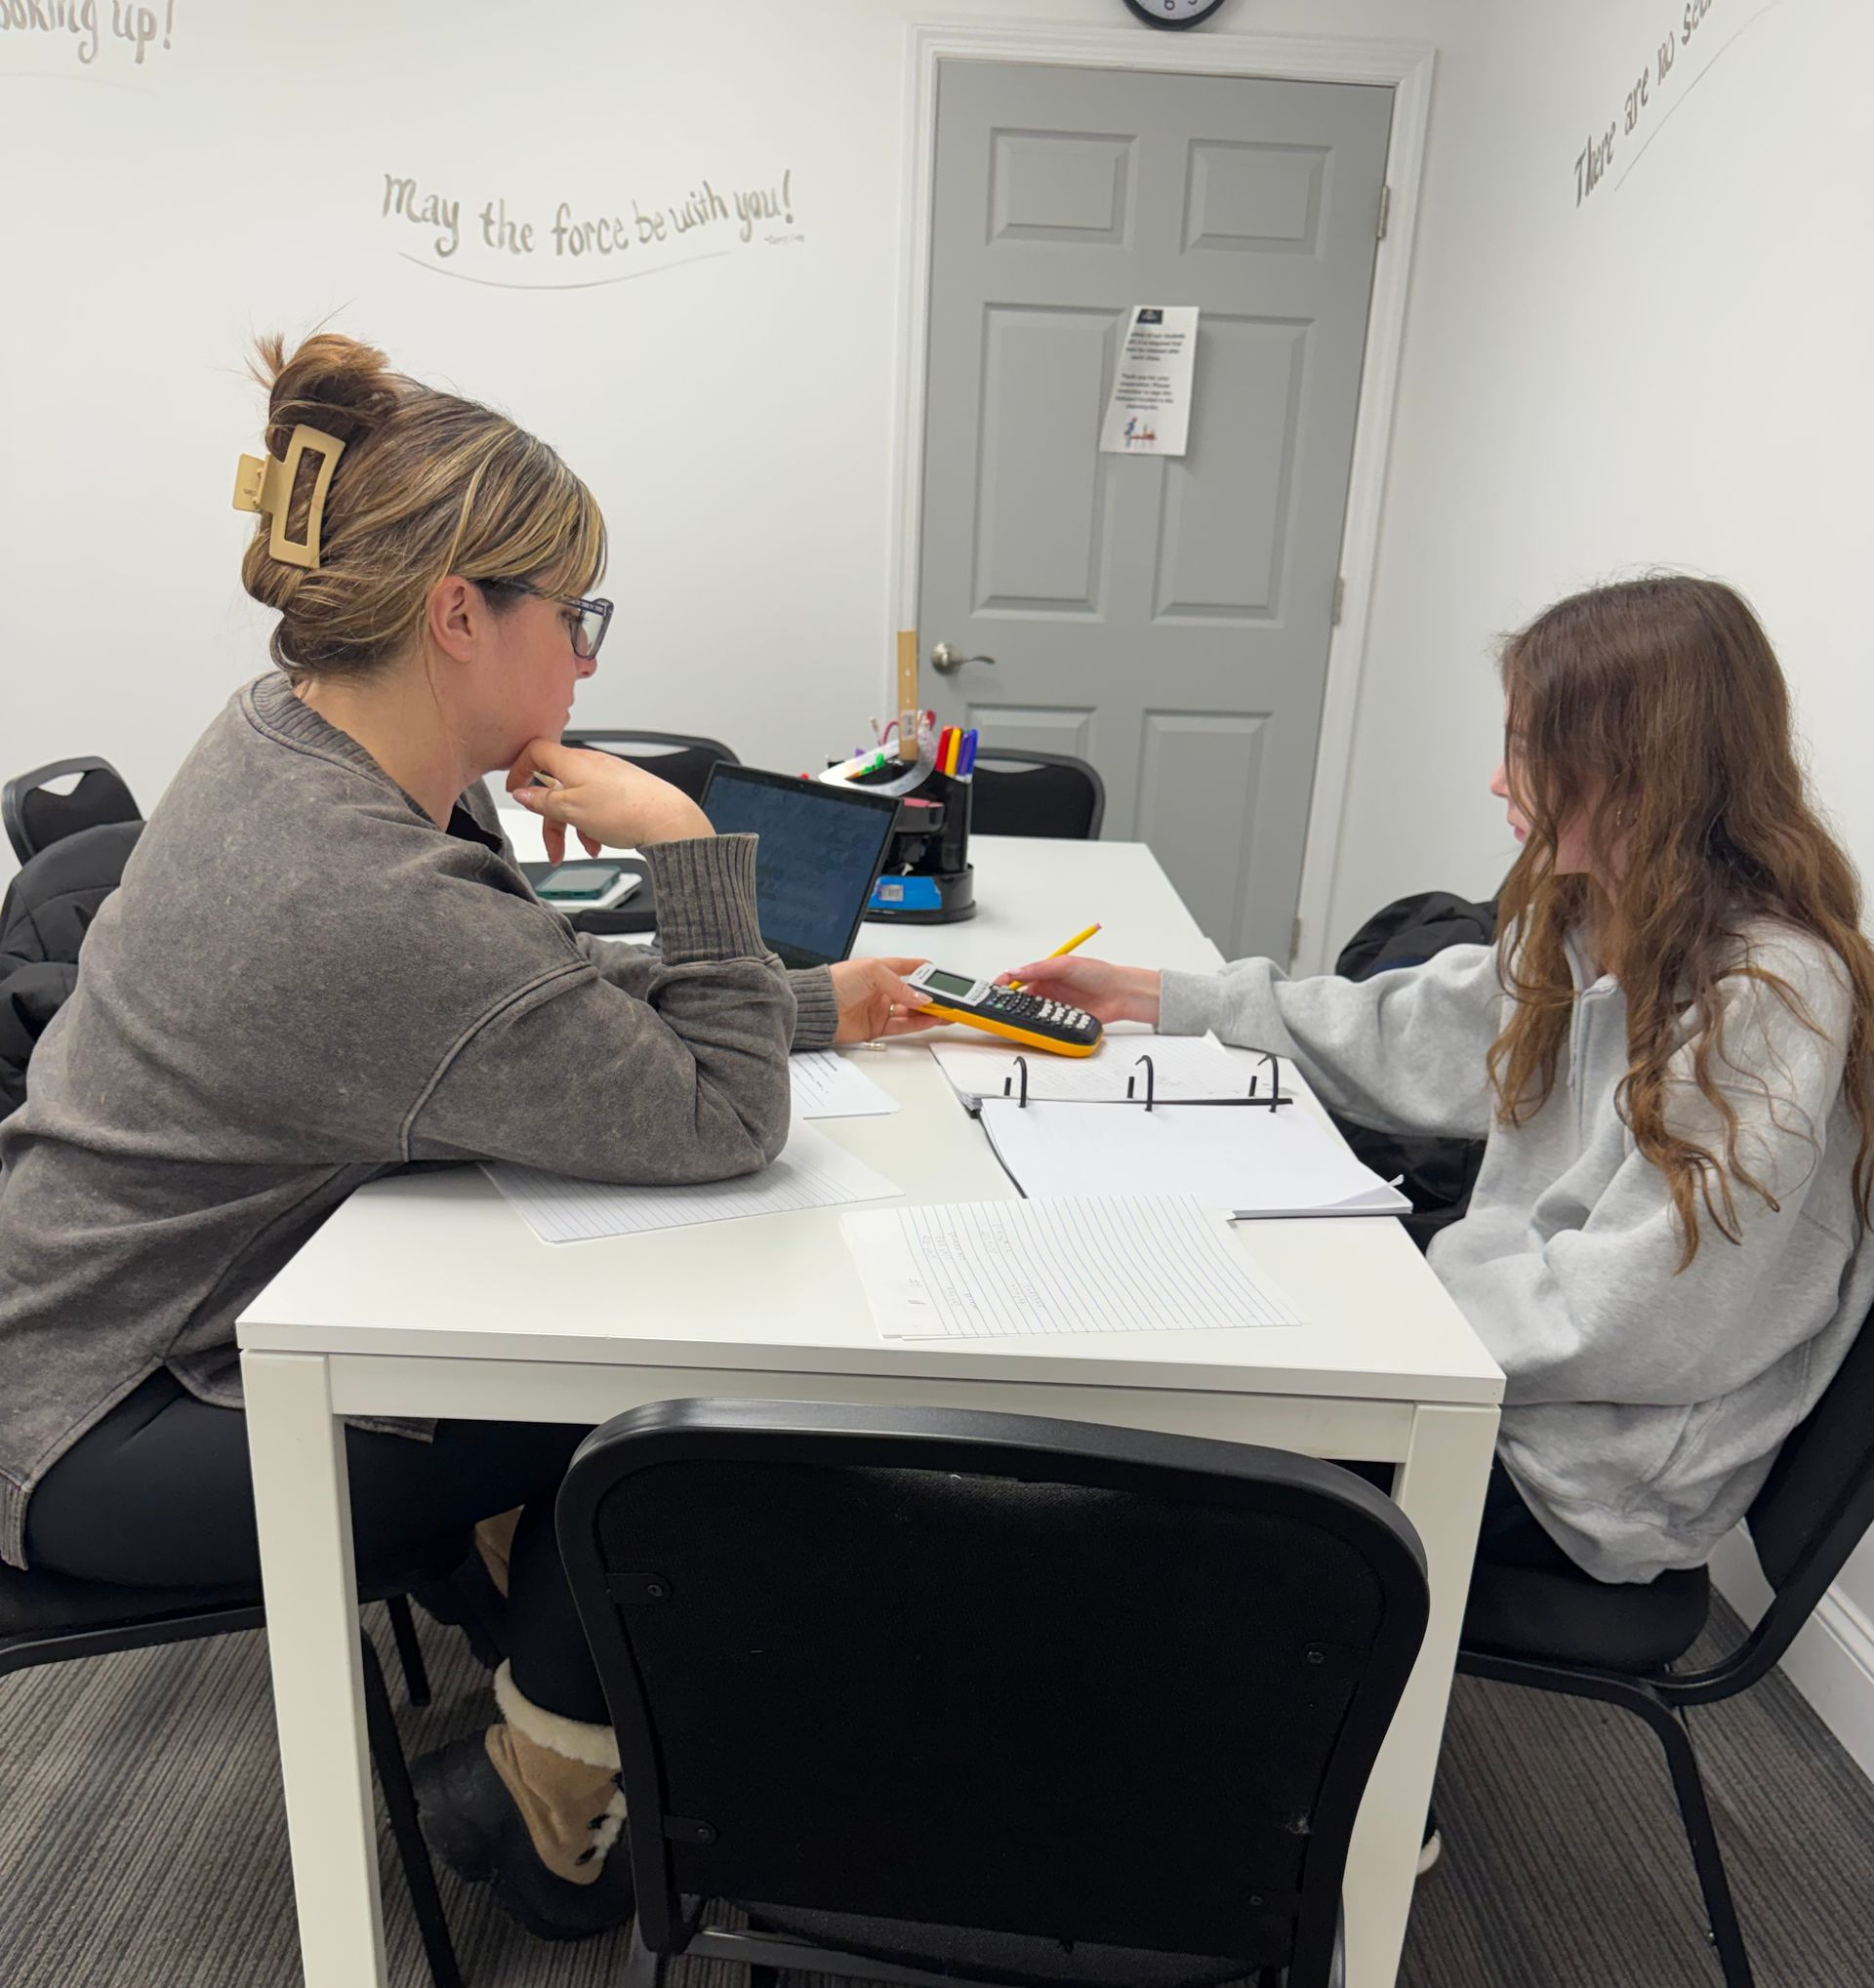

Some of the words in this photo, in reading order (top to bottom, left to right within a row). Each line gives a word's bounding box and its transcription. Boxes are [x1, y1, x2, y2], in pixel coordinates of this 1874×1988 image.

[112, 0, 174, 64] up!
[1573, 121, 1617, 208] There
[1621, 66, 1650, 136] are
[1656, 30, 1675, 86] no
[383, 174, 460, 258] May
[478, 198, 534, 255] the
[550, 202, 629, 257] force
[632, 200, 667, 243] be
[669, 180, 730, 234] with
[734, 168, 794, 244] you!
